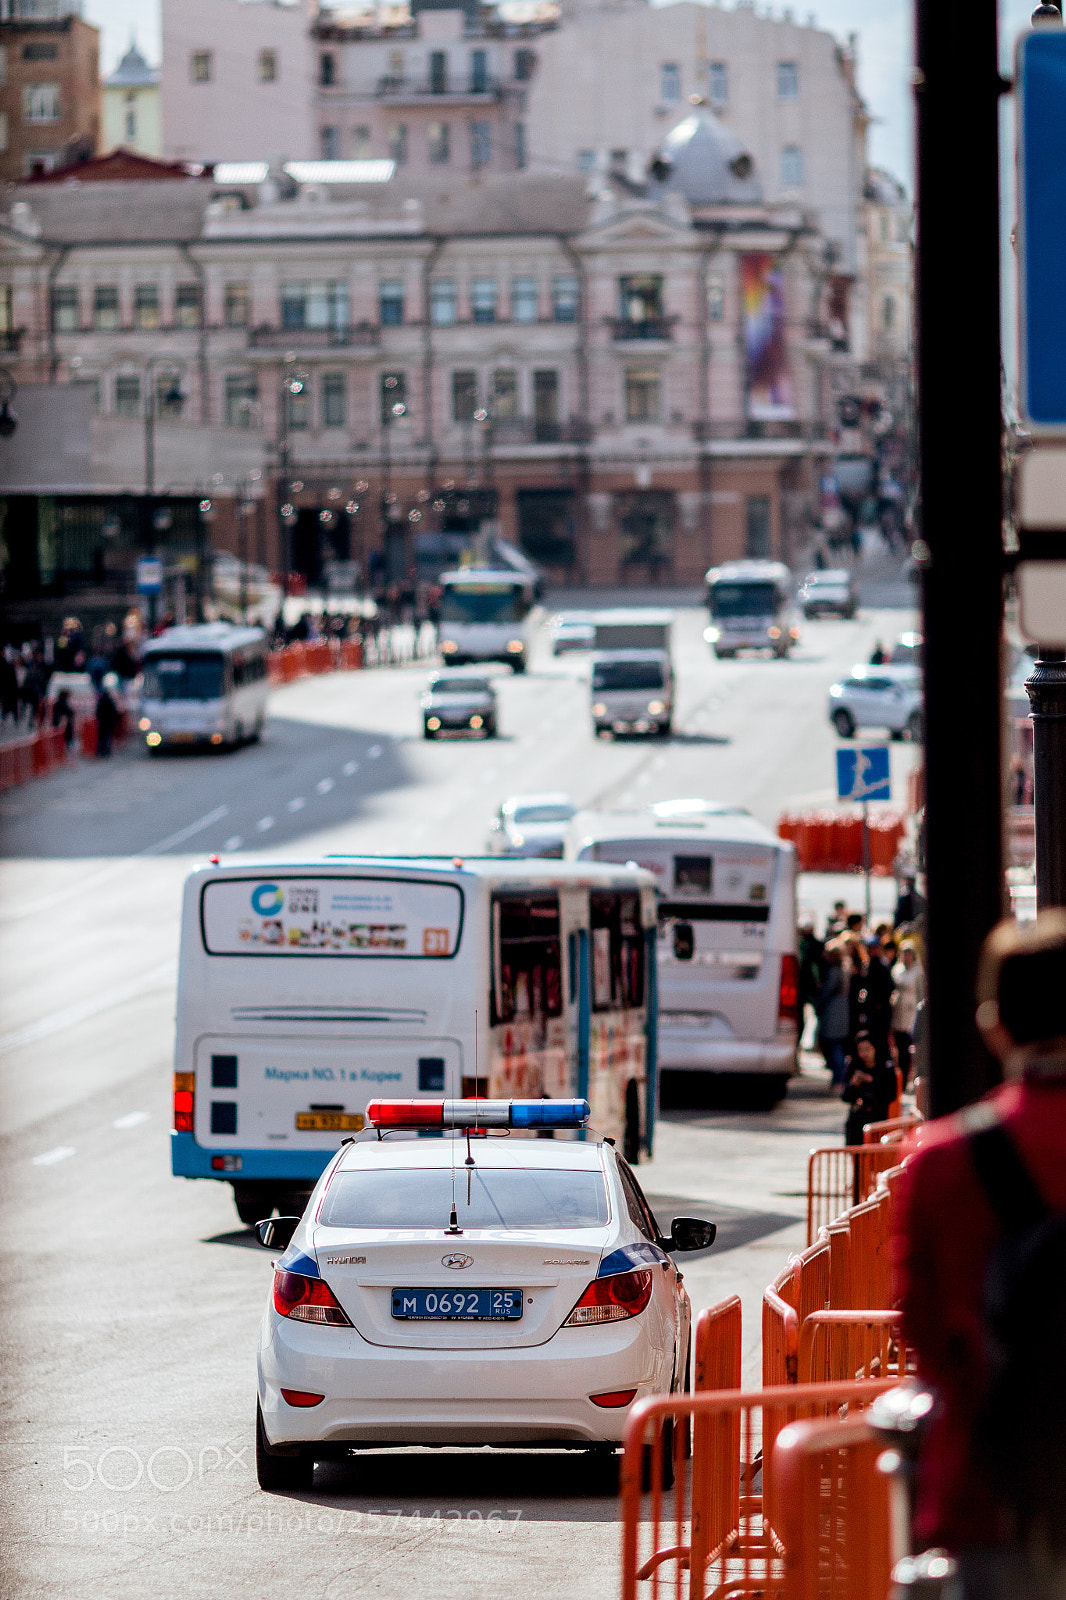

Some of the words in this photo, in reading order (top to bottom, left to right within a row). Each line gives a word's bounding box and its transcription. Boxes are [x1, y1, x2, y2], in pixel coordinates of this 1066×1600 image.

[265, 1067, 309, 1082] Марка
[361, 1069, 402, 1084] Корее
[327, 1256, 367, 1264] HYUNDAI
[425, 1293, 479, 1313] 0692
[493, 1292, 513, 1308] 25
